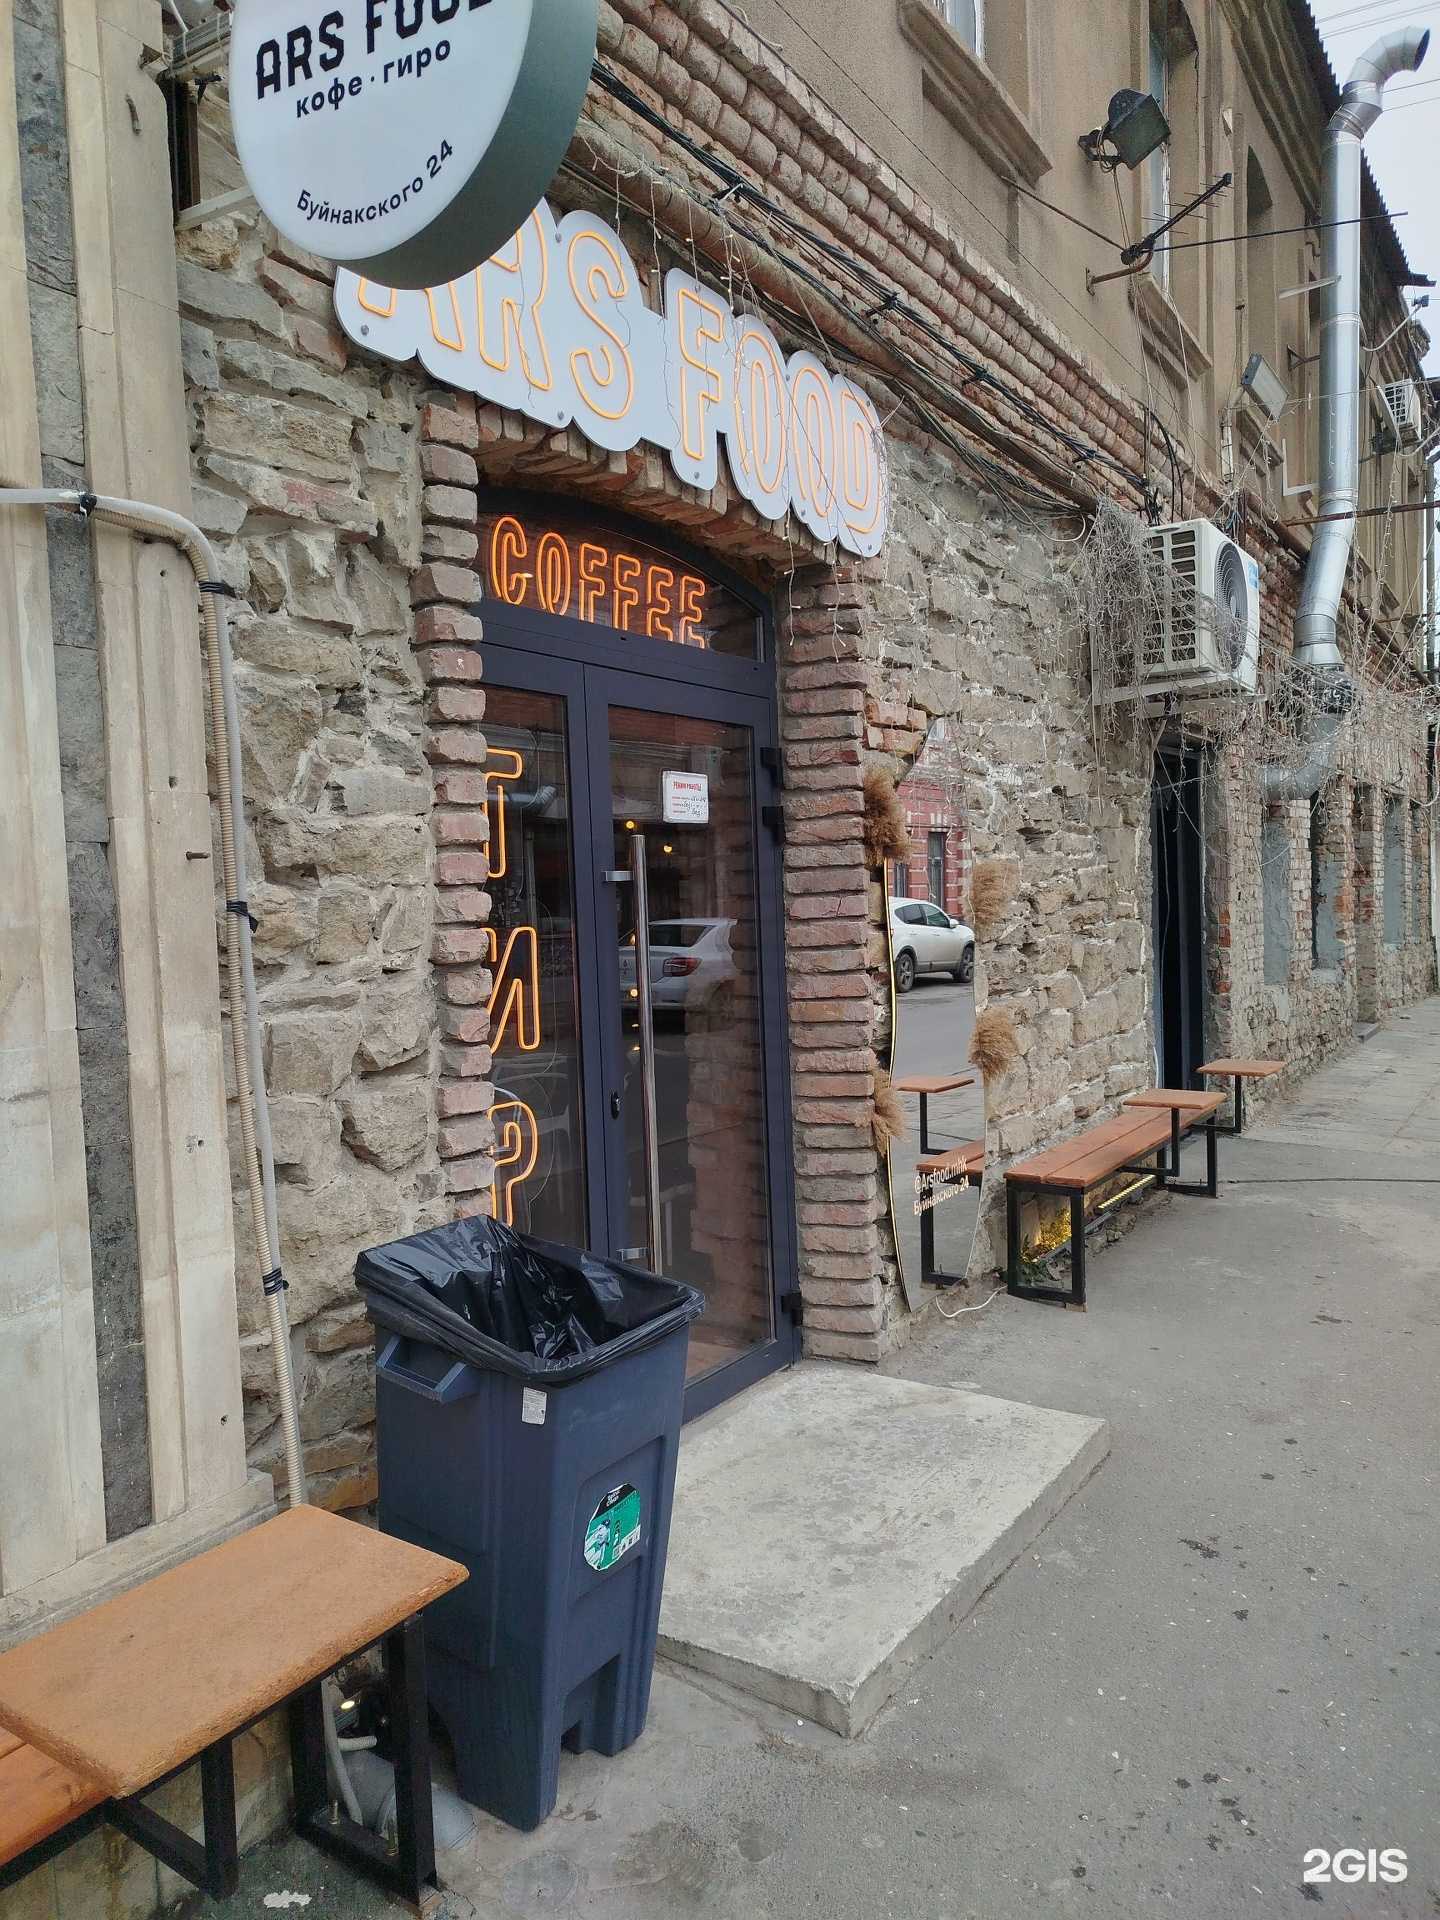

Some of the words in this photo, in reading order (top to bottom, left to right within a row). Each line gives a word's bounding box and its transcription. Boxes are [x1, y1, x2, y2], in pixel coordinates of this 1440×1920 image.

[256, 10, 345, 100] ARS
[296, 75, 363, 119] кофе
[383, 39, 451, 84] гиро
[297, 175, 424, 225] Буйнакского
[426, 139, 453, 179] 24
[677, 287, 883, 535] FOOD
[491, 516, 706, 650] COFFEE
[959, 1174, 970, 1192] 24
